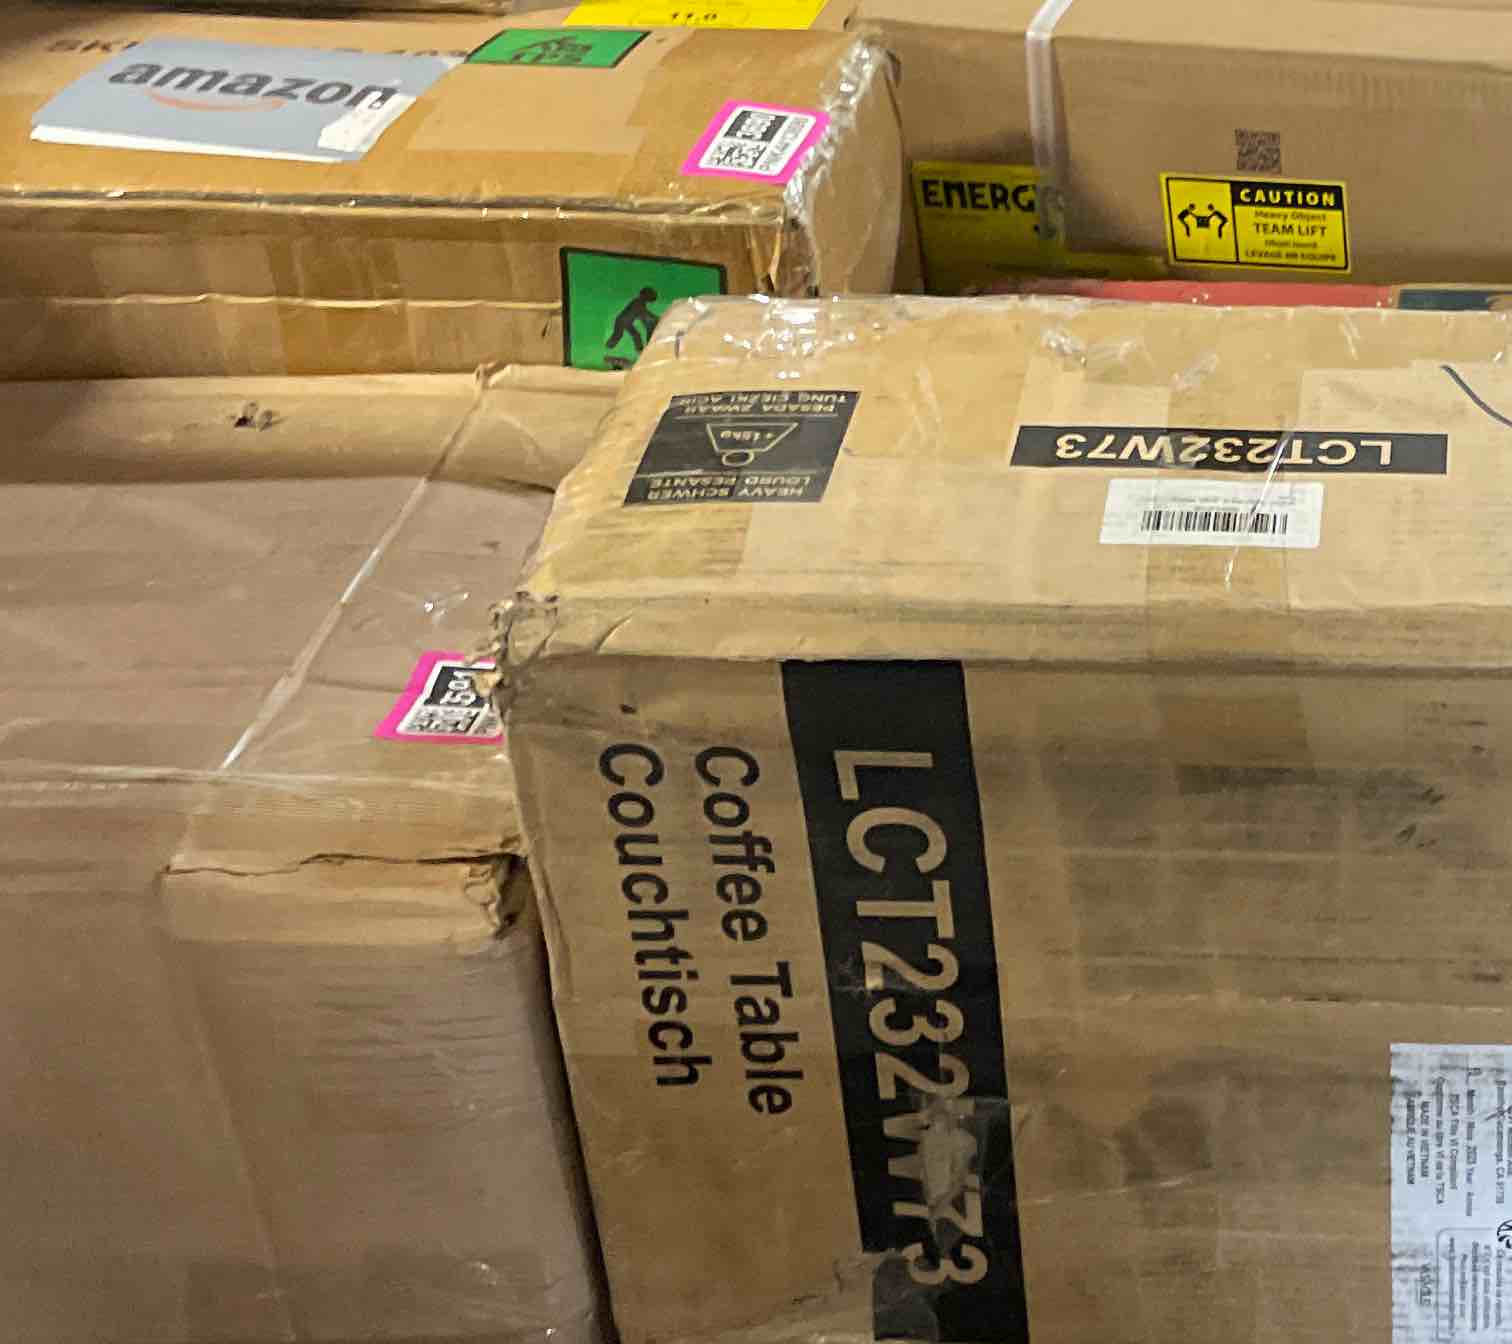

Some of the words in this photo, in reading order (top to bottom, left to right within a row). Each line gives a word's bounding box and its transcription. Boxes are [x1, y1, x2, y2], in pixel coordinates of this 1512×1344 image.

[108, 59, 400, 112] amazon
[1239, 187, 1337, 207] CAUTION
[1253, 223, 1296, 236] TEAM
[1297, 224, 1329, 238] LIFT
[1054, 432, 1393, 467] LCT232W73
[645, 487, 731, 500] SCHWER
[693, 745, 776, 943] Coffee
[597, 741, 714, 1090] Couchtisch
[729, 959, 806, 1117] Table
